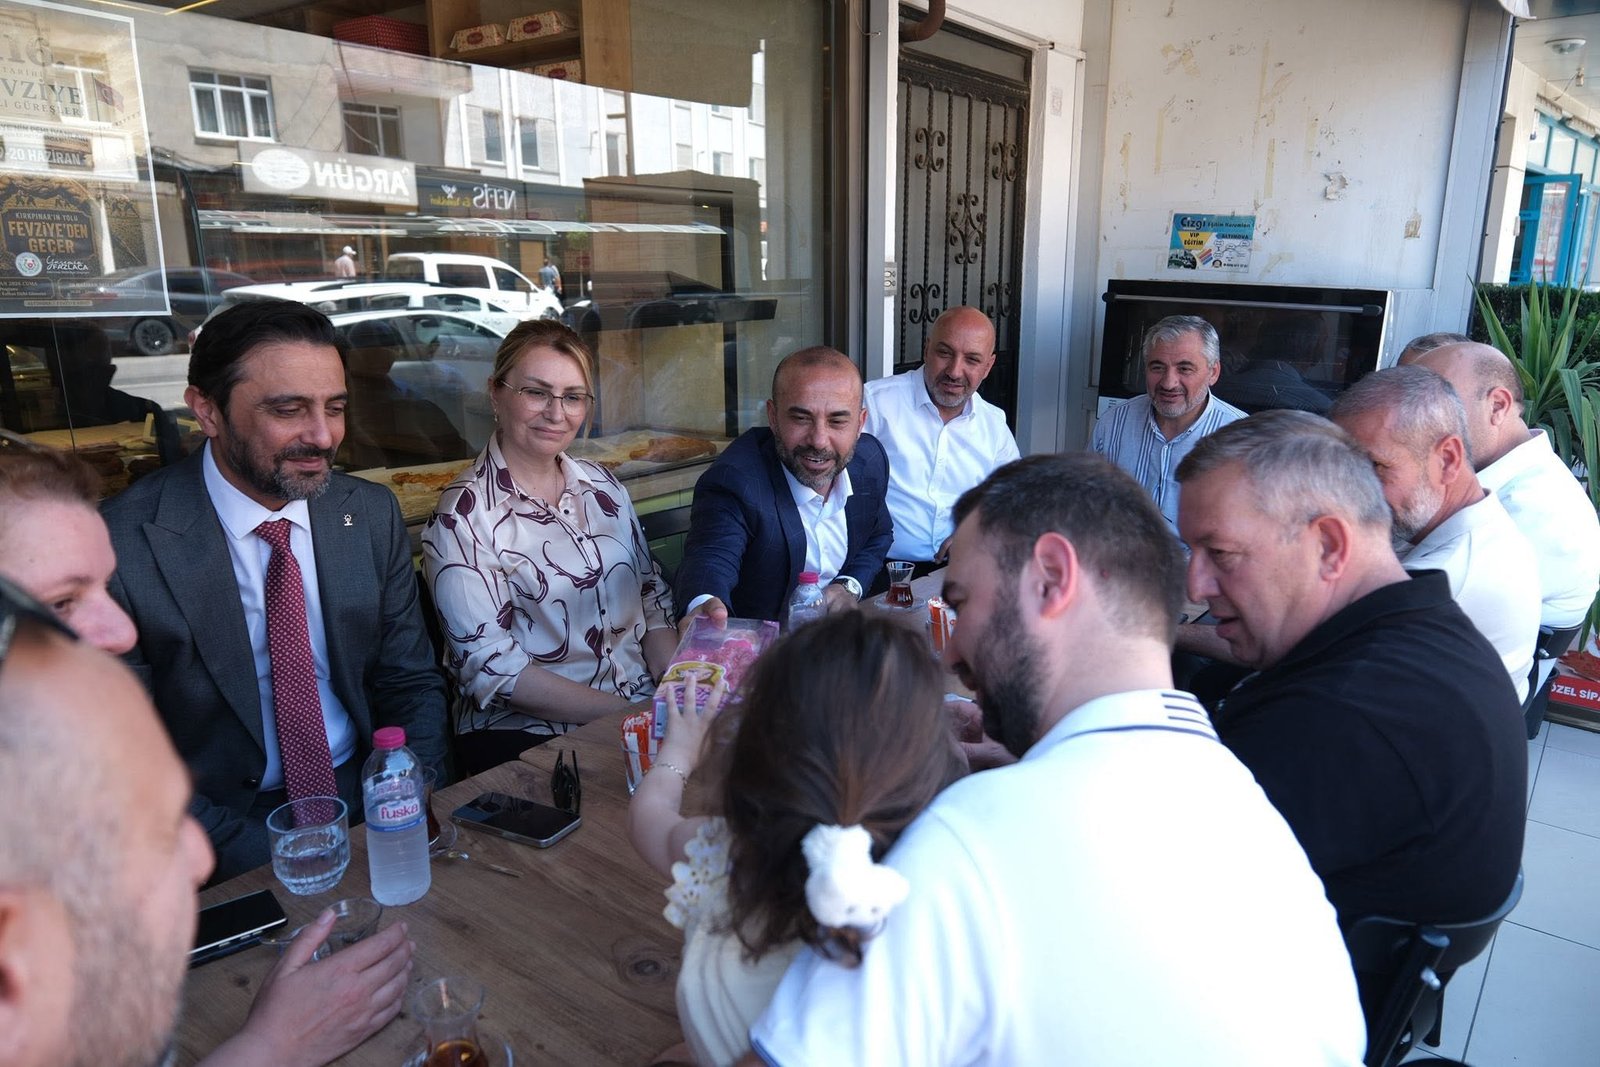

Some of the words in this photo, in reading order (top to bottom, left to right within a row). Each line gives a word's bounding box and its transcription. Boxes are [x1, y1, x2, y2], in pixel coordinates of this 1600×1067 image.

[0, 77, 82, 105] VZİYE
[8, 147, 25, 160] 20
[28, 149, 81, 165] HAZİRAN
[8, 221, 88, 239] FEVZİYE'DEN
[29, 239, 75, 254] GEÇER
[381, 804, 418, 819] fuska
